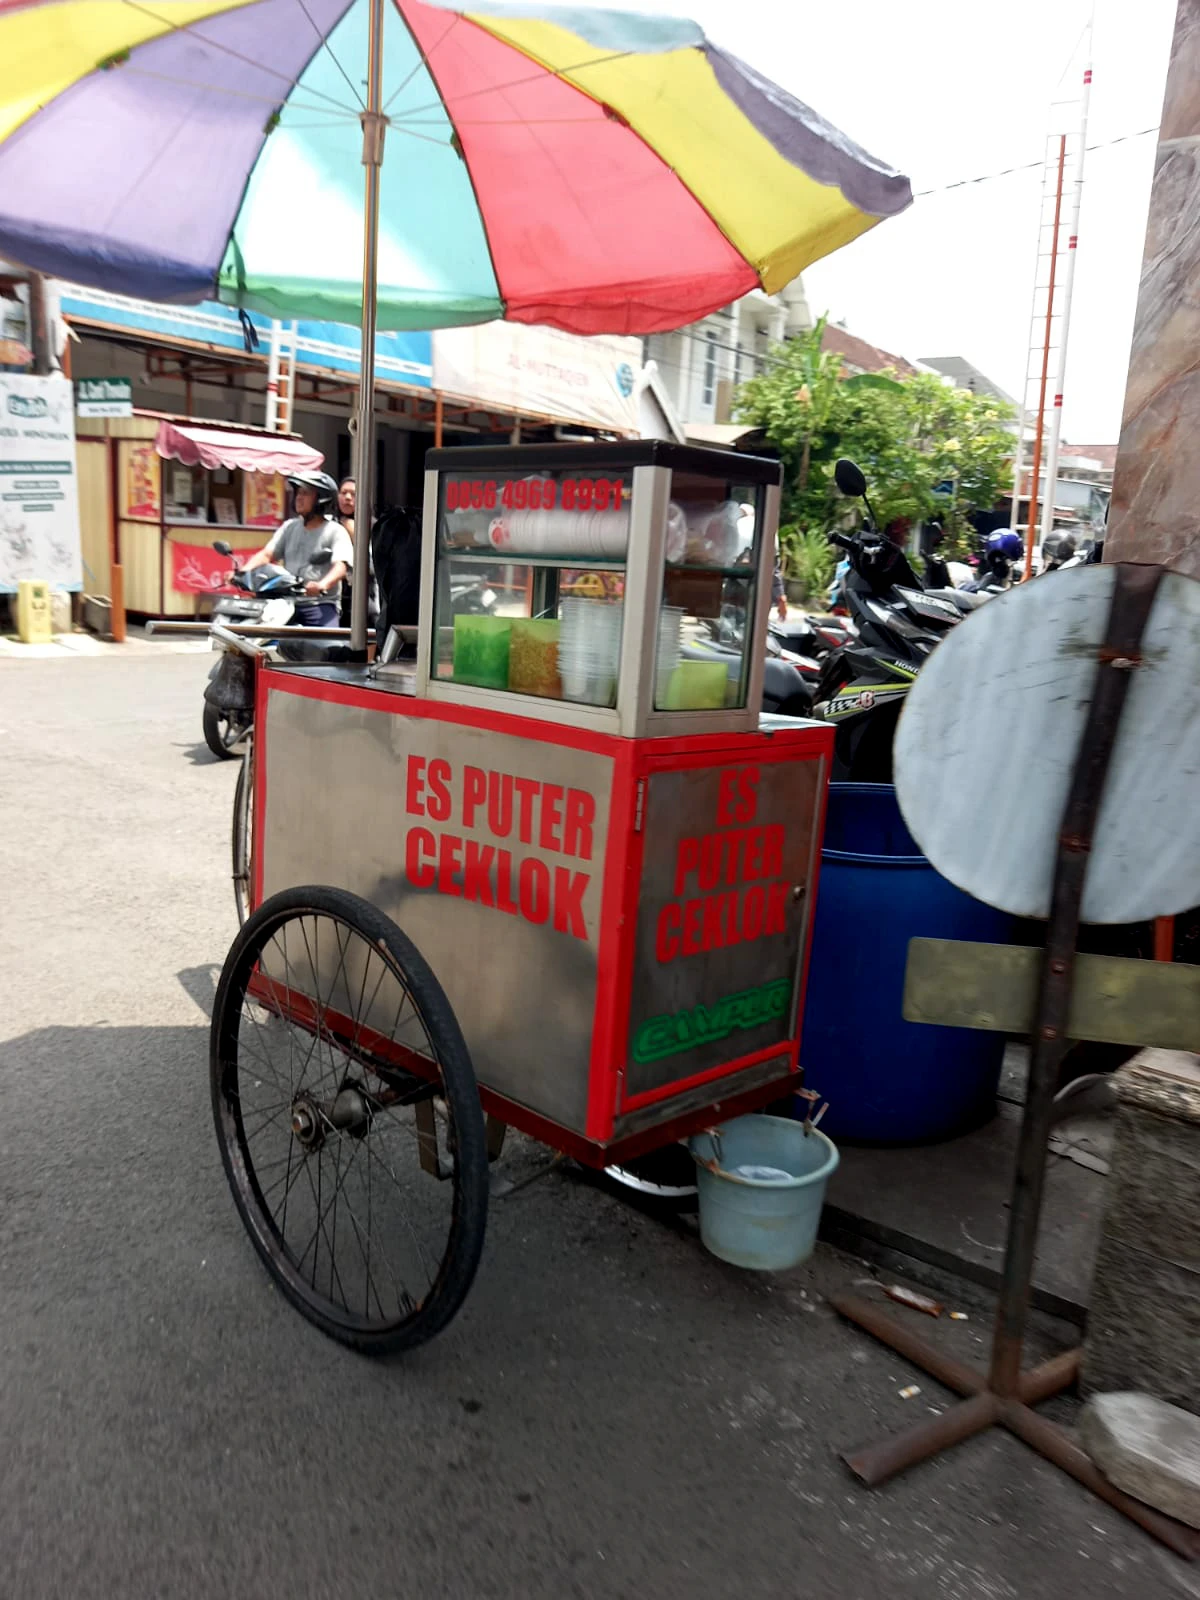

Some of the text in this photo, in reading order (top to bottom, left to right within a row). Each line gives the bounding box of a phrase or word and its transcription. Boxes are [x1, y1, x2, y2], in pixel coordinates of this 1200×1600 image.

[502, 479, 556, 510] 4969
[561, 478, 626, 512] 8991
[894, 660, 920, 674] HOND
[406, 755, 596, 860] ES PUTER
[716, 768, 760, 826] ES
[405, 827, 591, 941] CEKLOK
[674, 824, 784, 895] PUTER
[656, 883, 787, 962] CEKLOK
